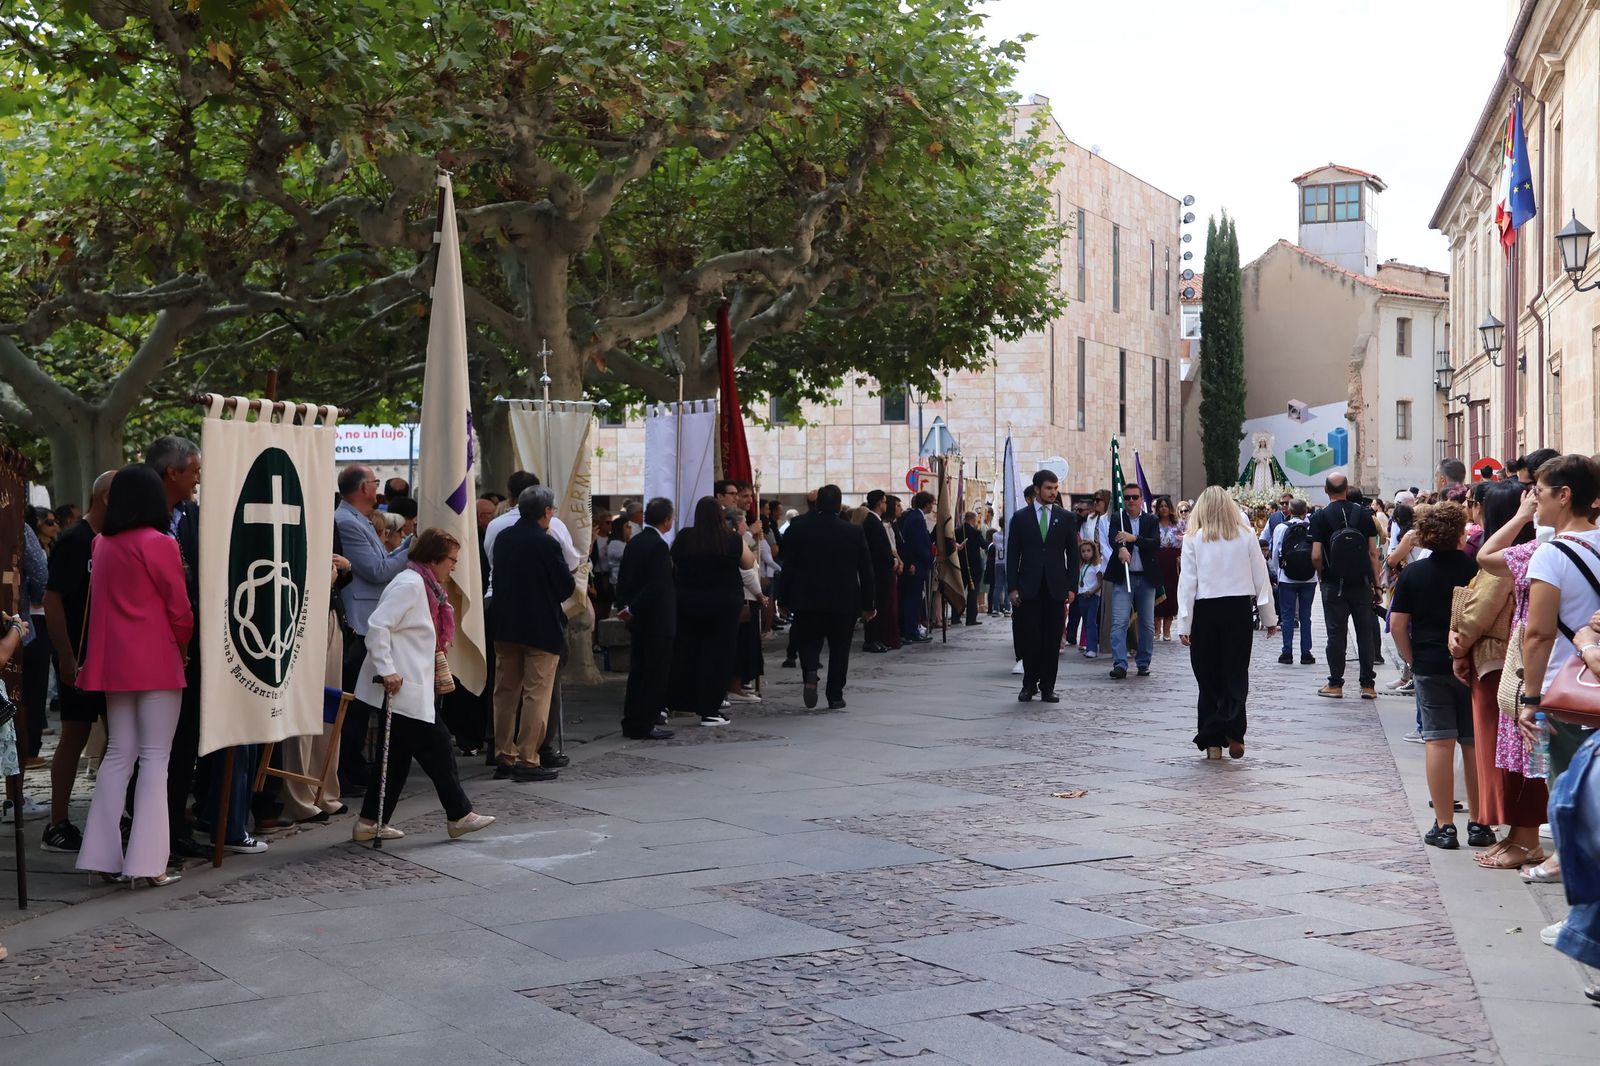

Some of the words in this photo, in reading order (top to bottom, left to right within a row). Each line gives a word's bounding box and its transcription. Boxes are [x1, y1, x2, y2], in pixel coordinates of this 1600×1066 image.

[345, 431, 360, 439] no
[363, 431, 378, 439] un
[381, 429, 407, 440] lujo.
